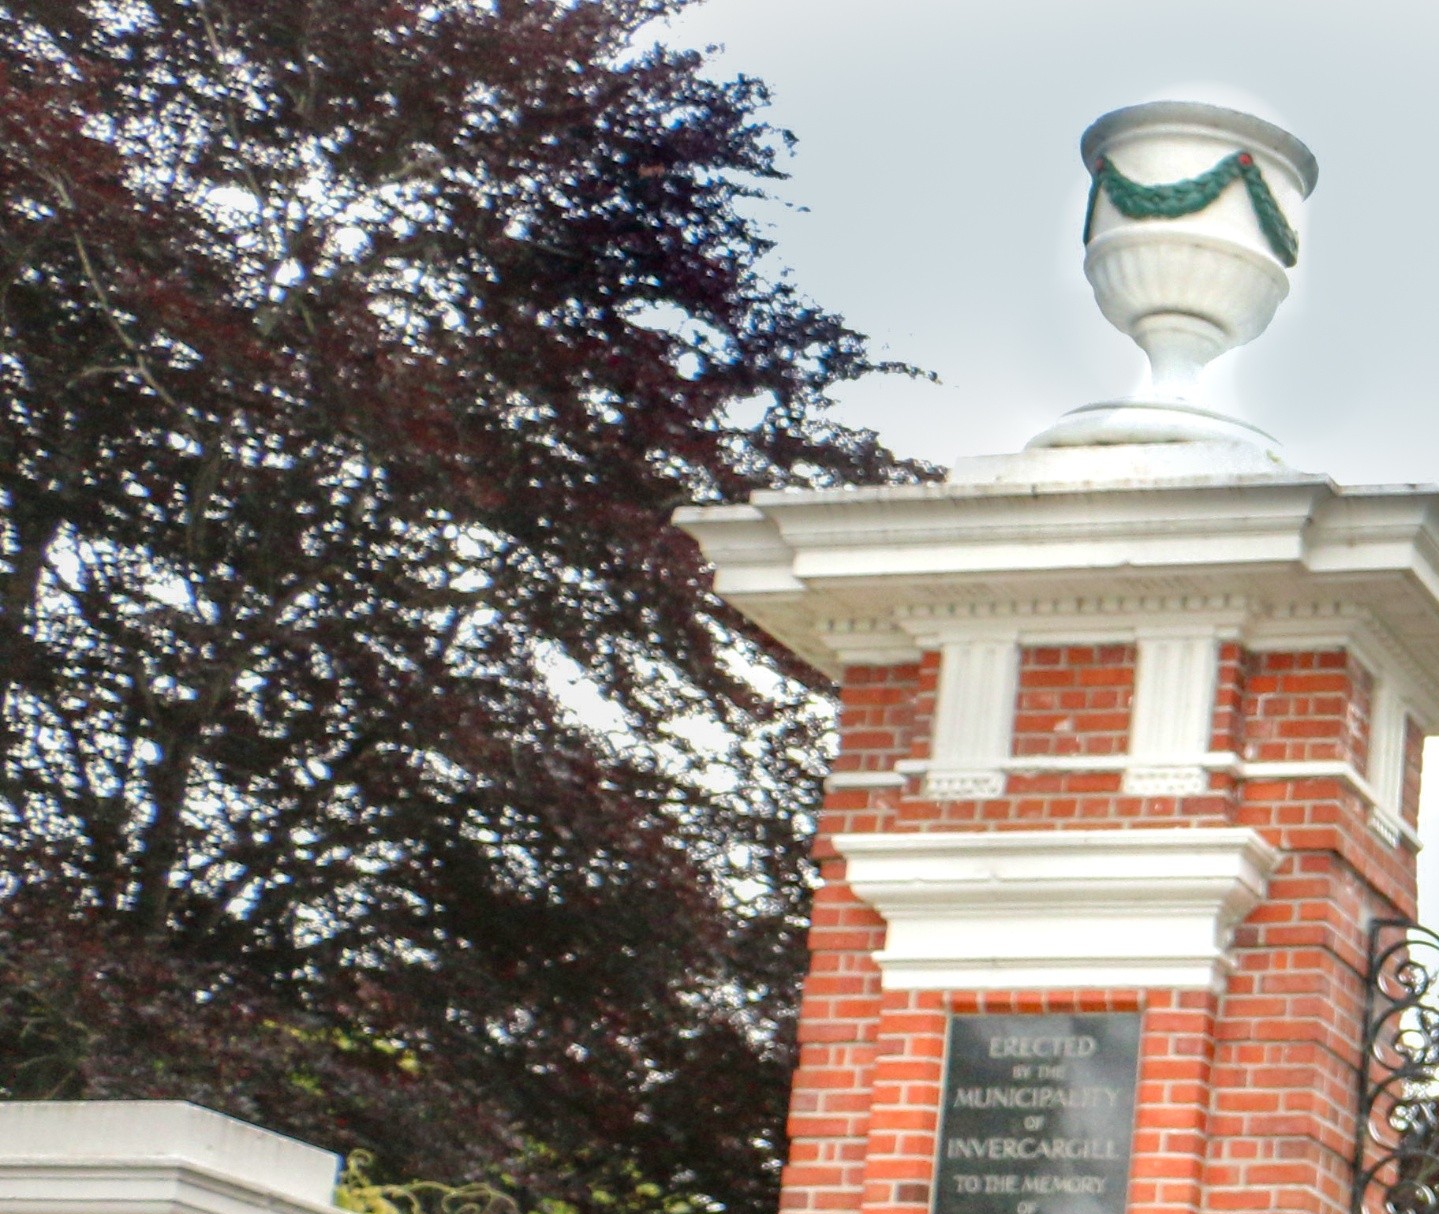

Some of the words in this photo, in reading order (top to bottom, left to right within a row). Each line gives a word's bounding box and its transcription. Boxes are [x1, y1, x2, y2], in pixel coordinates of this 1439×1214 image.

[988, 1035, 1096, 1058] ERECTED
[1012, 1065, 1032, 1079] BY
[1038, 1065, 1065, 1080] THE
[953, 1087, 1119, 1108] MUNICIPALITY
[1024, 1115, 1045, 1131] OF
[947, 1138, 1120, 1160] INVERCARGILL
[954, 1175, 978, 1193] TO
[984, 1175, 1019, 1193] THE
[1023, 1175, 1108, 1194] MEMORY
